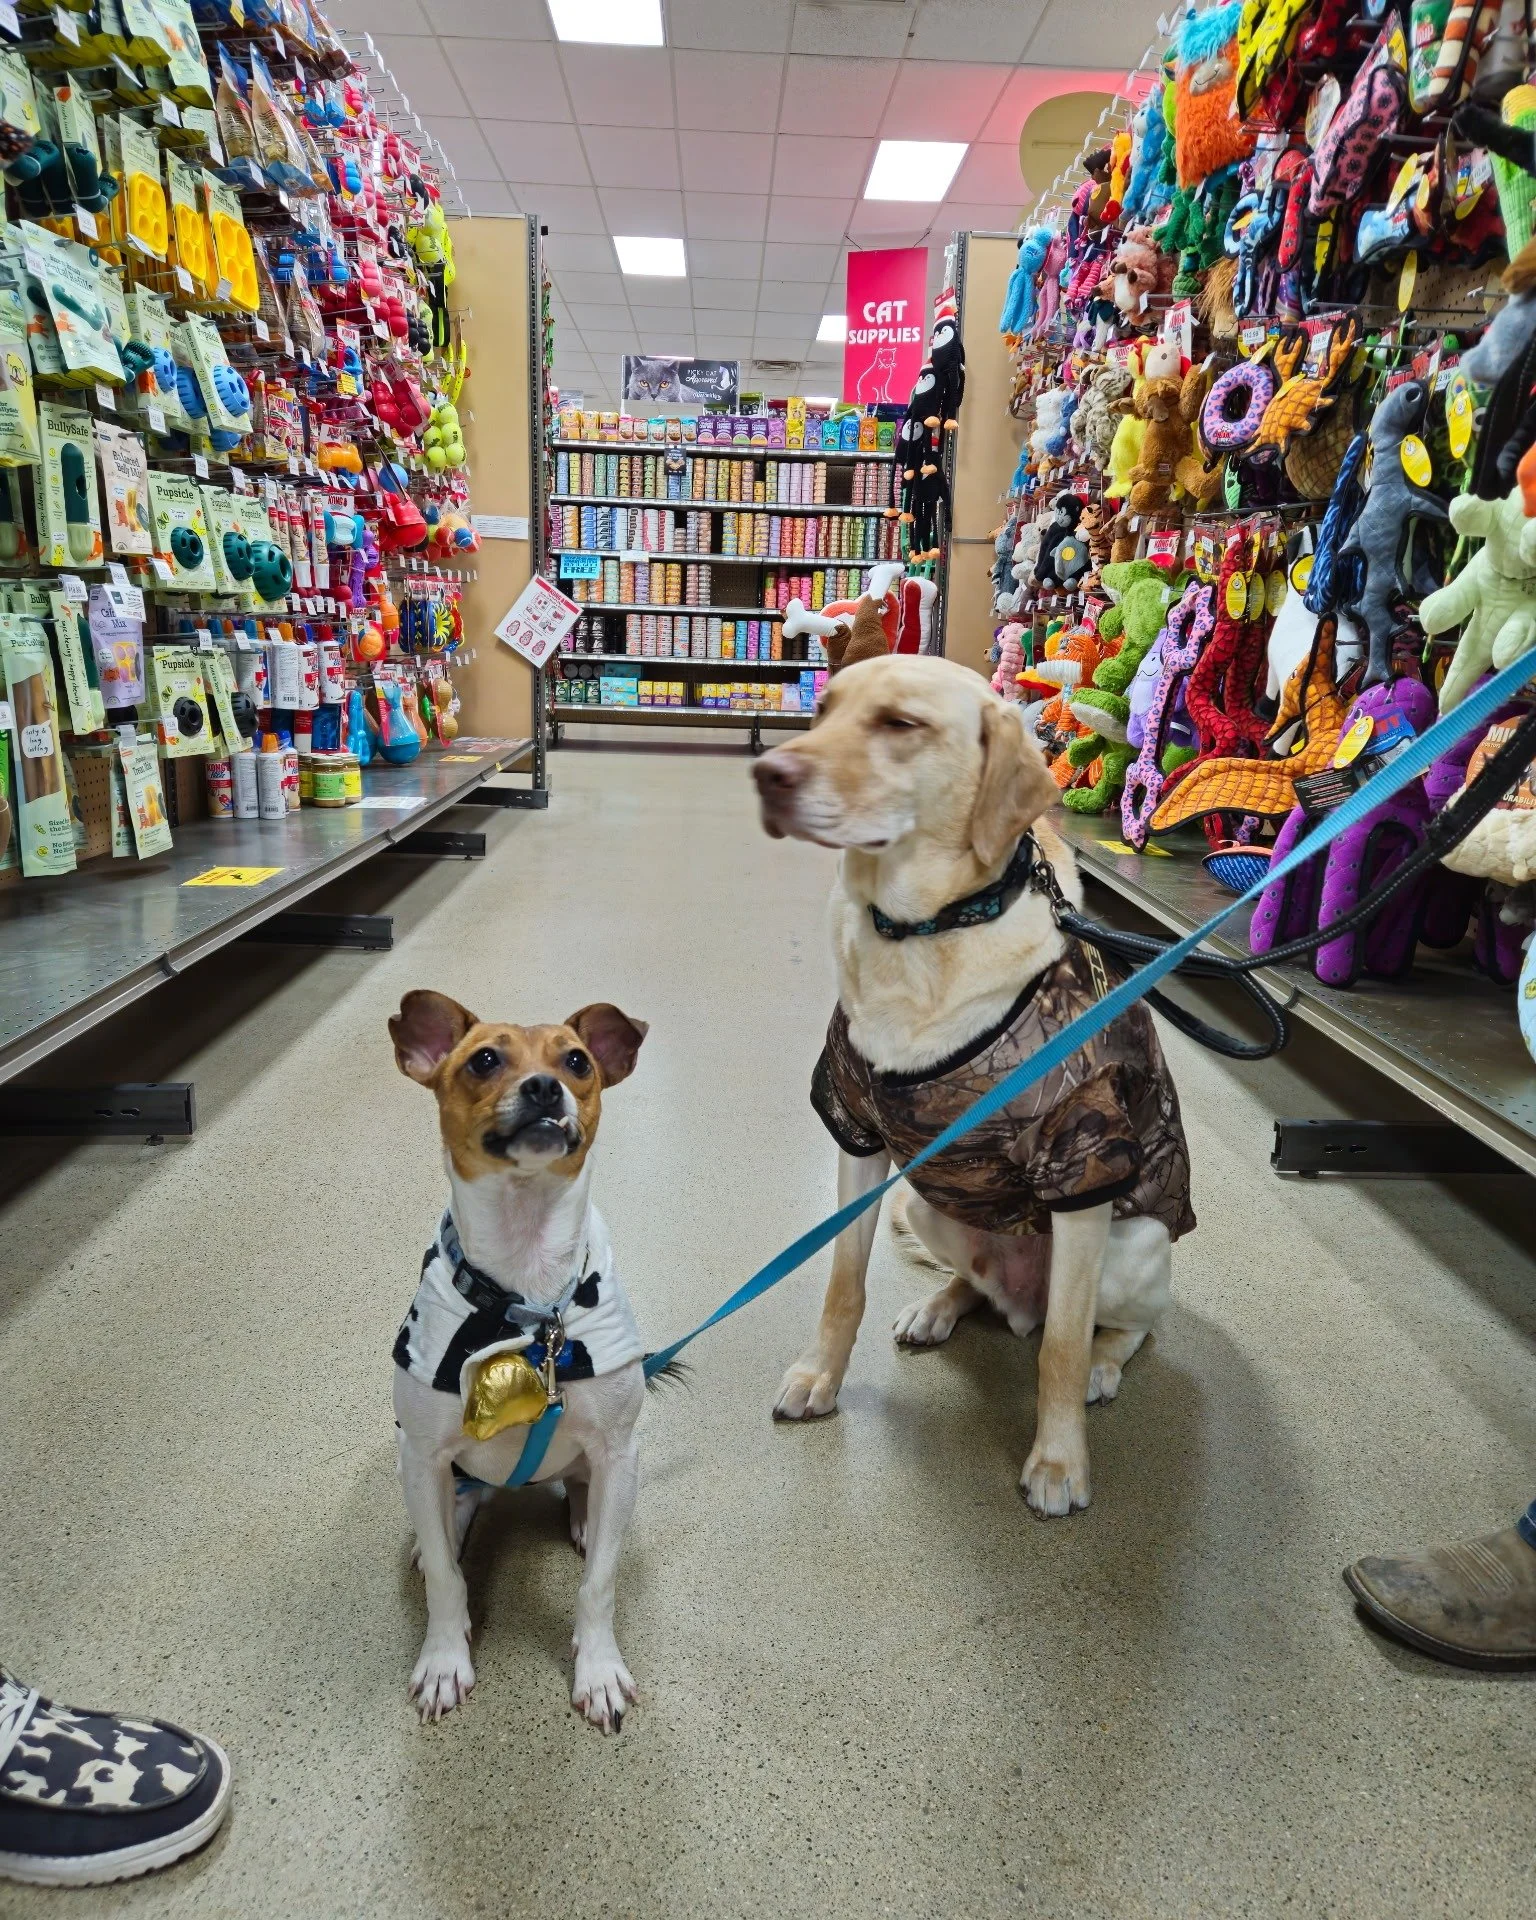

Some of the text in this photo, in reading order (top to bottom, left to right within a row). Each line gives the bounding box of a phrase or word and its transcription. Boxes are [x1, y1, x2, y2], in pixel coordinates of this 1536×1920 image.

[863, 299, 908, 326] CAT
[848, 327, 921, 345] SUPPLIES
[47, 419, 89, 438] BullySafe
[156, 485, 194, 500] Pupsicle
[240, 508, 262, 520] Pupsicle
[30, 593, 50, 606] Bully
[112, 619, 128, 629] Mix
[162, 659, 195, 670] Pupsicle
